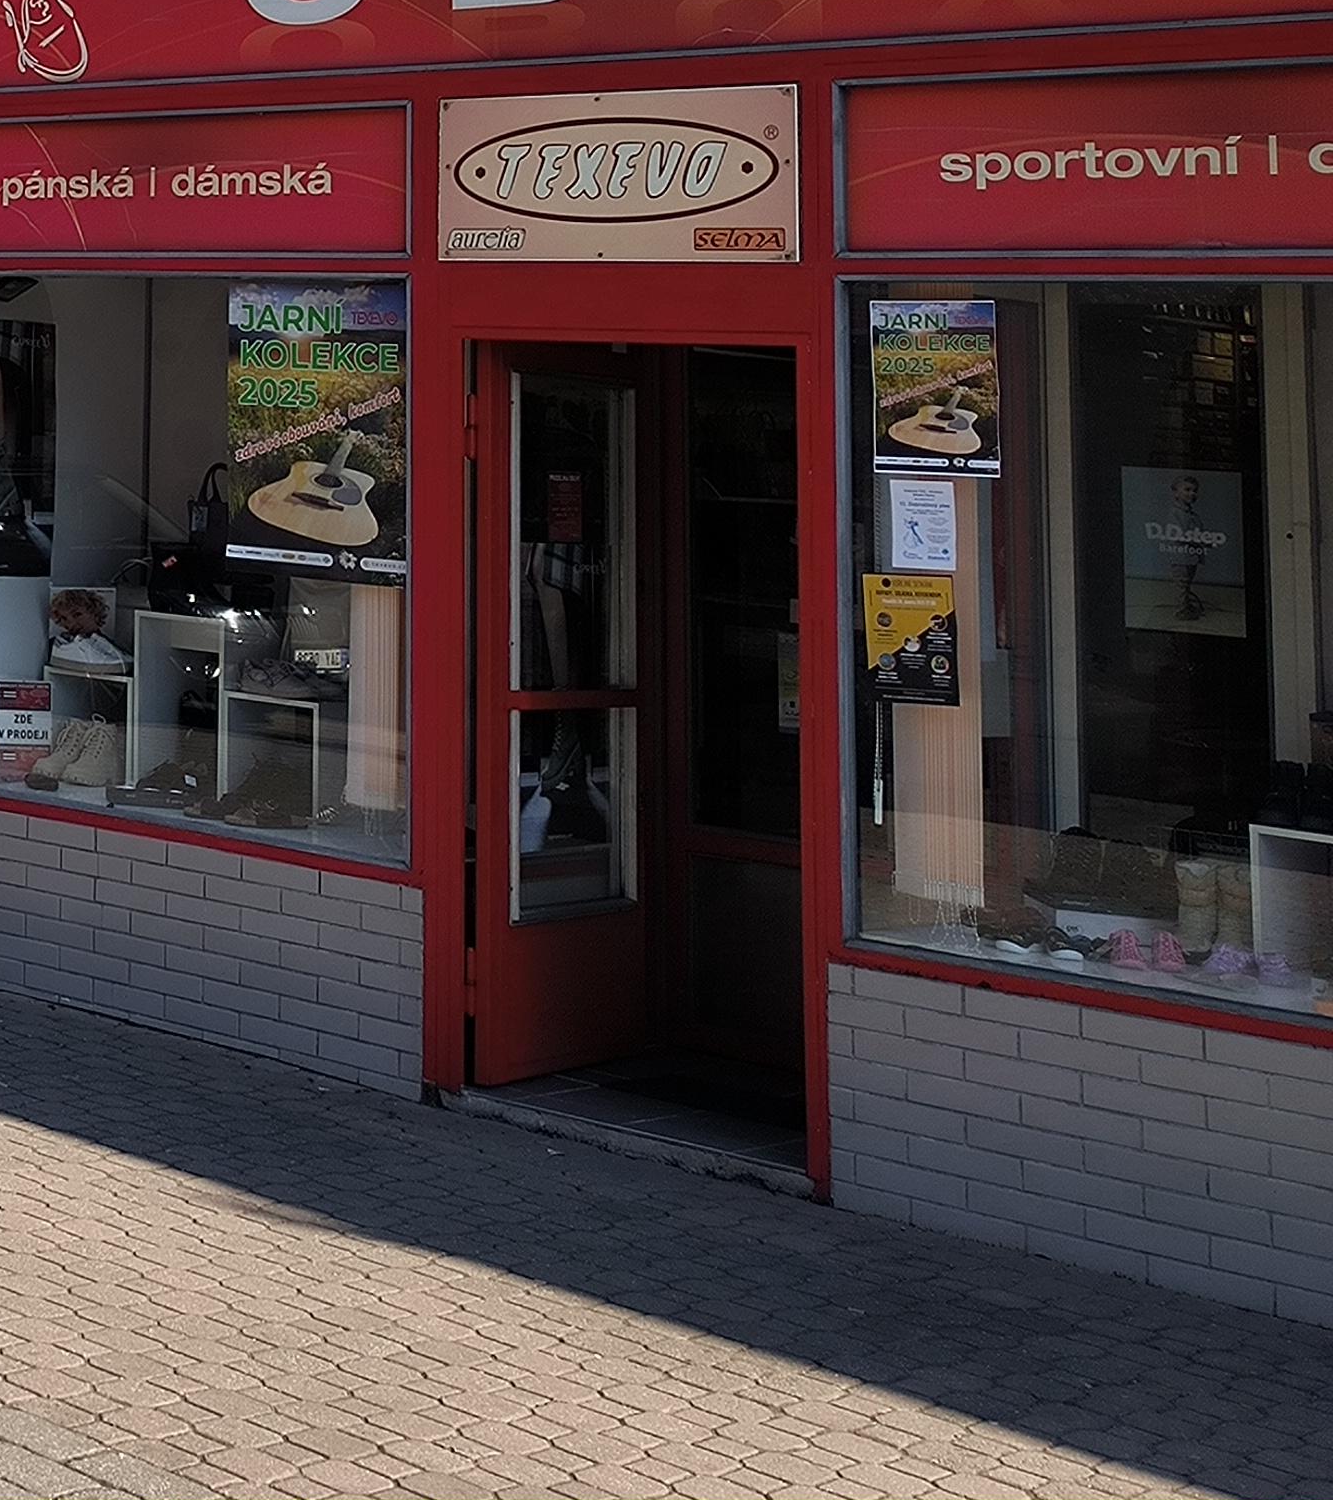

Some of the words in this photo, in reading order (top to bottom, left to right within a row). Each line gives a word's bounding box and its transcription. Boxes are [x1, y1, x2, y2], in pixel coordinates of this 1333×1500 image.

[497, 141, 728, 200] TEXEVO
[939, 134, 1243, 190] sportovní
[2, 167, 133, 206] pánská
[171, 162, 332, 198] dámská
[451, 226, 523, 250] aurelia
[695, 228, 784, 250] SELMA
[238, 298, 345, 334] JARNÍ
[239, 338, 401, 374] KOLEKCE
[879, 332, 991, 353] KOLEKCE
[880, 356, 936, 375] 2025
[237, 375, 318, 409] 2025
[347, 386, 402, 420] komfort
[7, 729, 49, 741] PRODEJI
[13, 714, 33, 725] ZDE
